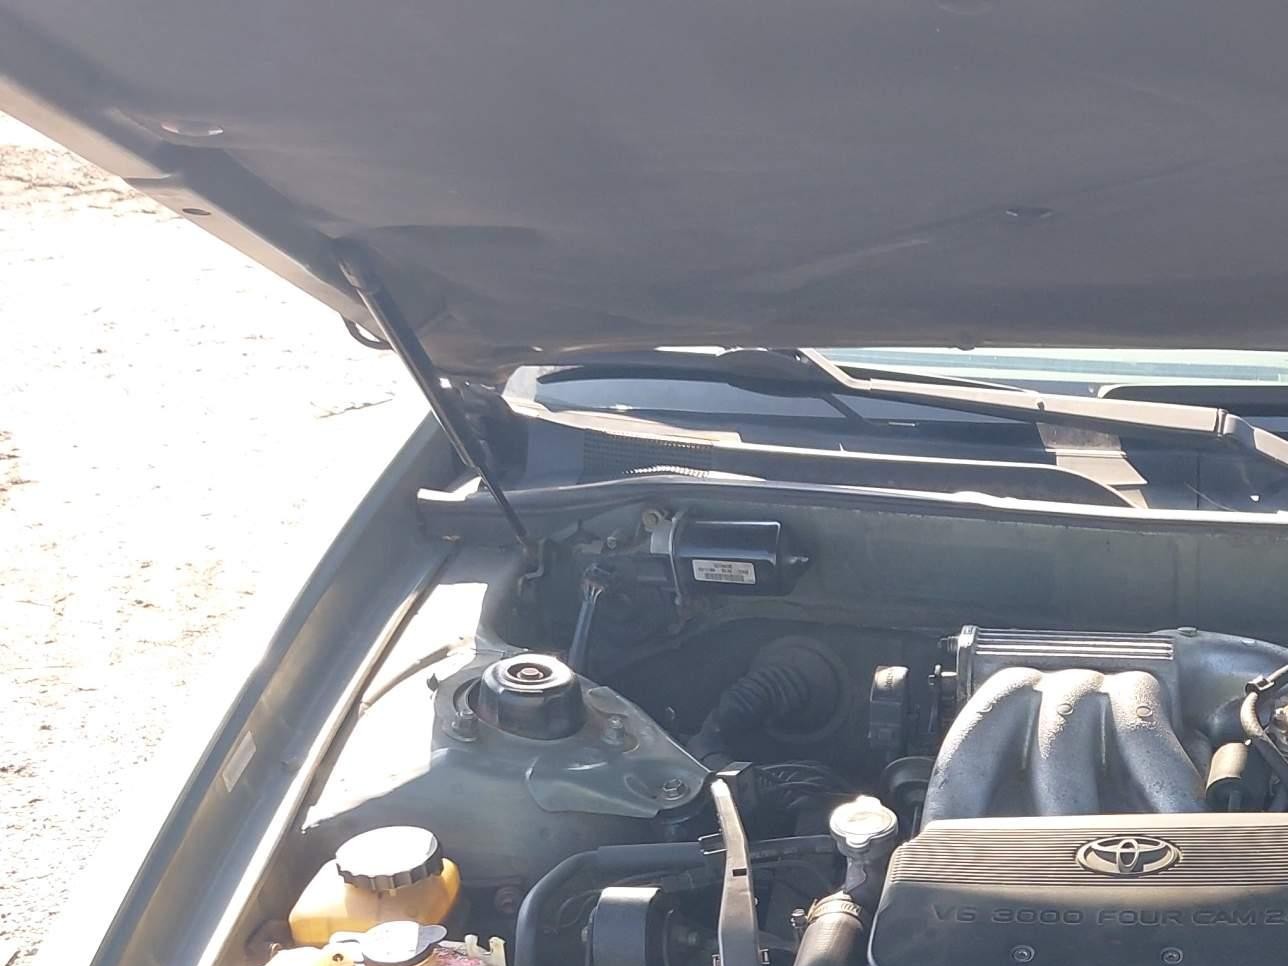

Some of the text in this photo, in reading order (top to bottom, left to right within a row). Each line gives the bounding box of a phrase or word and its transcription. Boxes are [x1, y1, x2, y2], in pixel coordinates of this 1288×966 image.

[931, 903, 977, 924] V6
[991, 907, 1084, 925] 3000
[1096, 908, 1185, 926] FOUR
[1190, 908, 1257, 926] CAM
